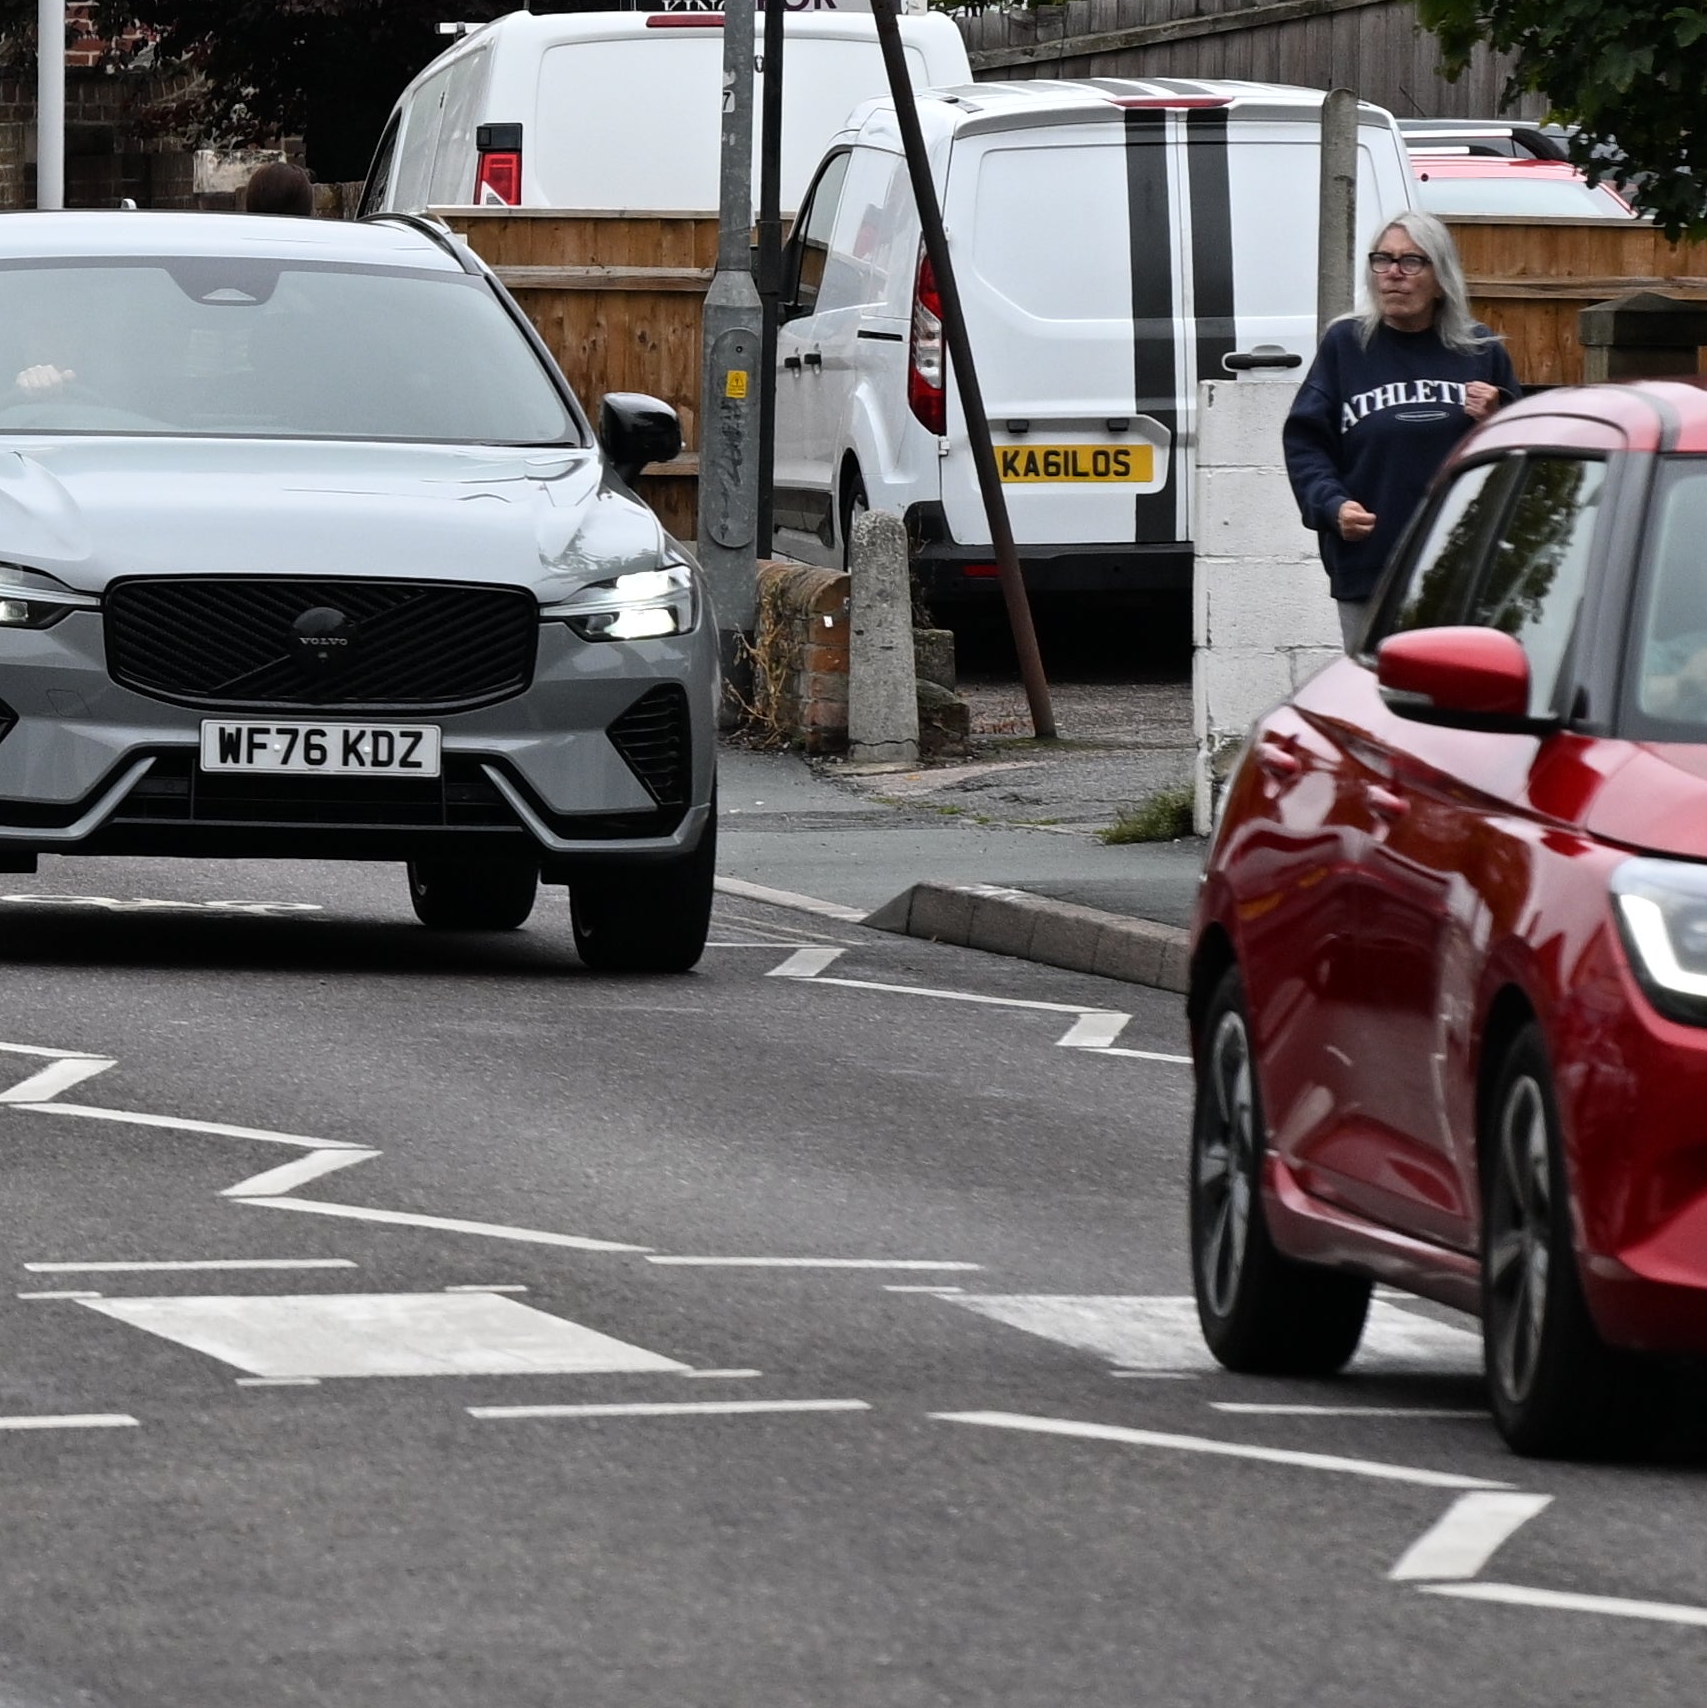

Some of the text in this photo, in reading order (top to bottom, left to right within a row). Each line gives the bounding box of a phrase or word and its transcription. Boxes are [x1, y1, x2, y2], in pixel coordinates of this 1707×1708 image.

[1340, 379, 1466, 434] ATHLETI
[299, 637, 348, 646] VOLVO
[218, 727, 423, 768] WF76 KDZ
